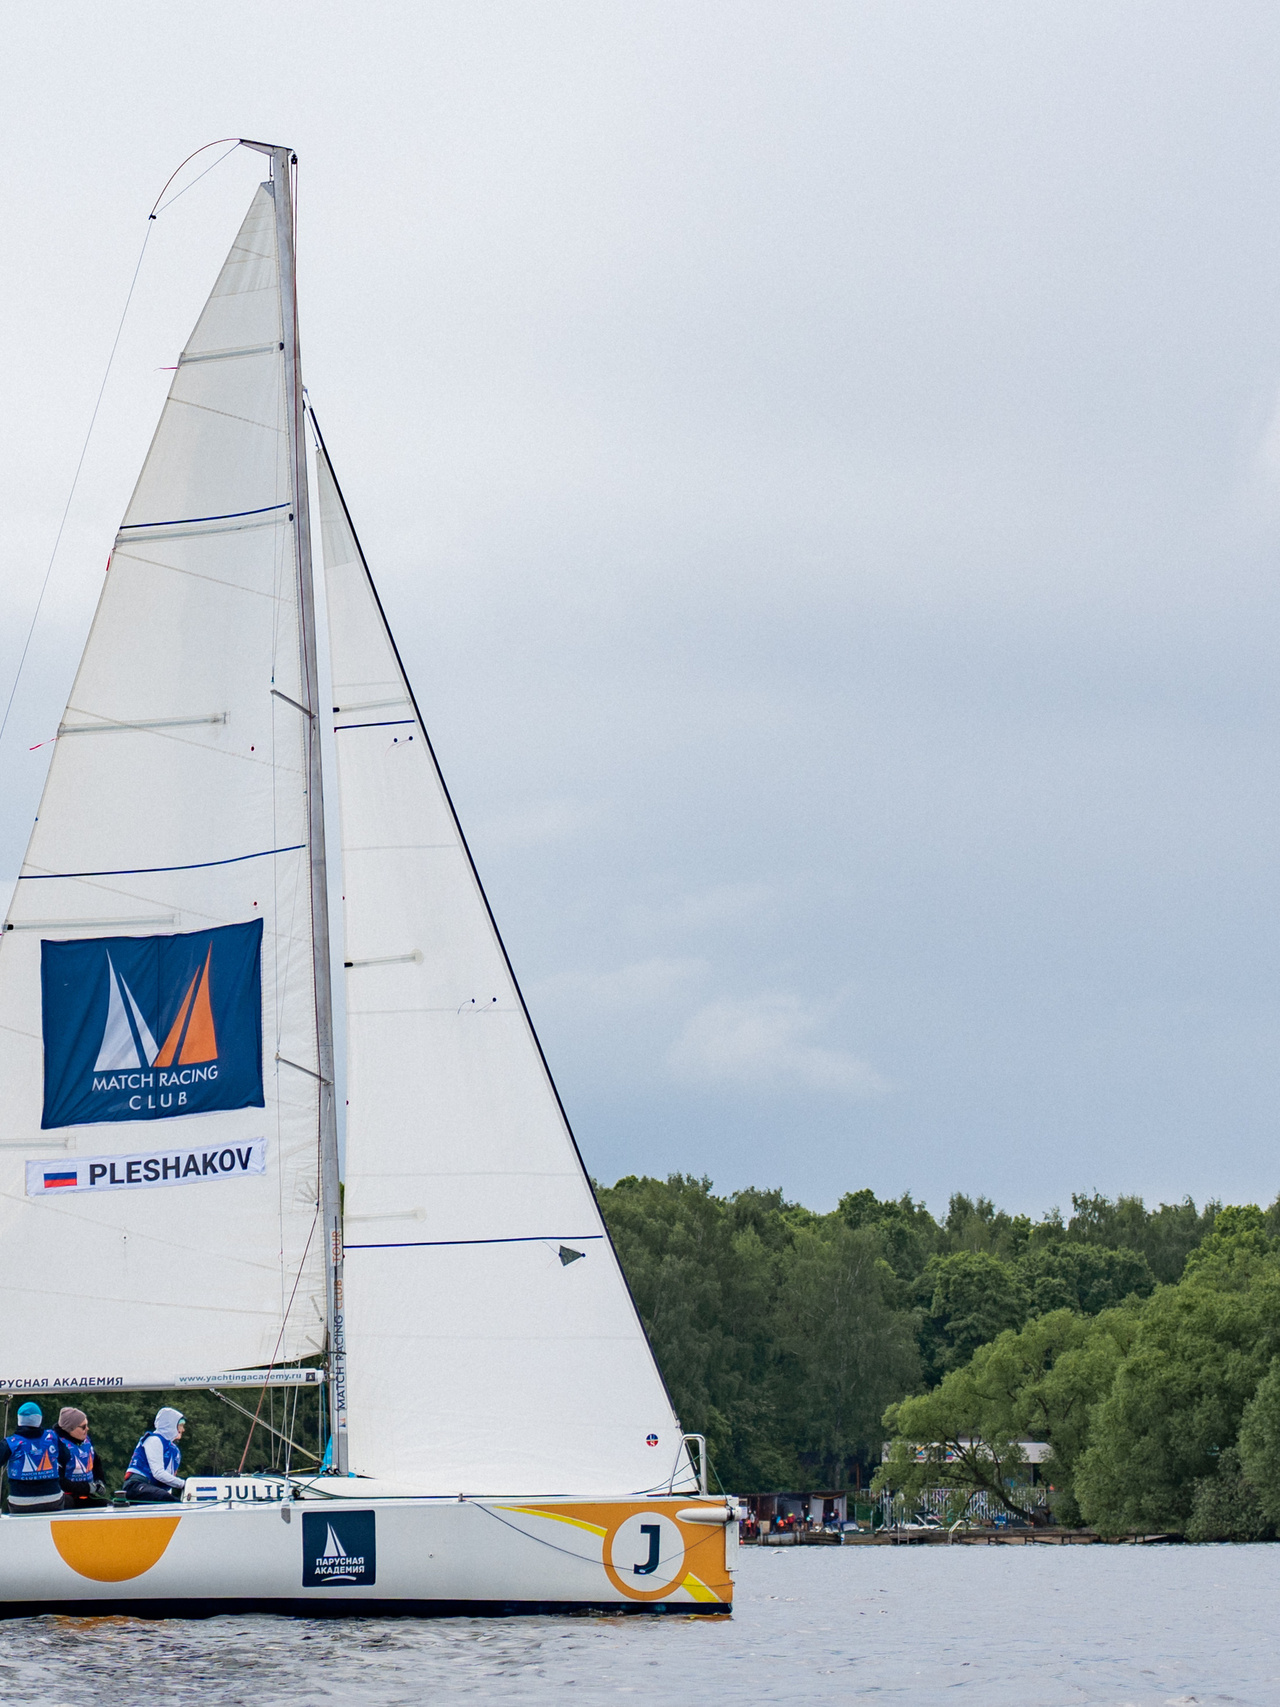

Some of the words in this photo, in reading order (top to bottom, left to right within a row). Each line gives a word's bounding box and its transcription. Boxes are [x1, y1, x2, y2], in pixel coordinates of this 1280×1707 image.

[92, 1073, 153, 1092] MATCH
[159, 1065, 218, 1087] RACING
[129, 1091, 188, 1110] CLUB
[89, 1146, 253, 1186] PLESHAKOV
[332, 1230, 342, 1263] TOUR
[333, 1279, 343, 1310] CLUB
[333, 1315, 344, 1361] RACING
[53, 1376, 124, 1389] АКАДЕМИЯ
[179, 1372, 302, 1383] www.yachtingacademy.ru
[335, 1366, 346, 1410] MATCH
[315, 1556, 365, 1567] ПАРУСНАЯ
[633, 1524, 660, 1575] J
[314, 1565, 365, 1575] АКАДЕМИЯ
